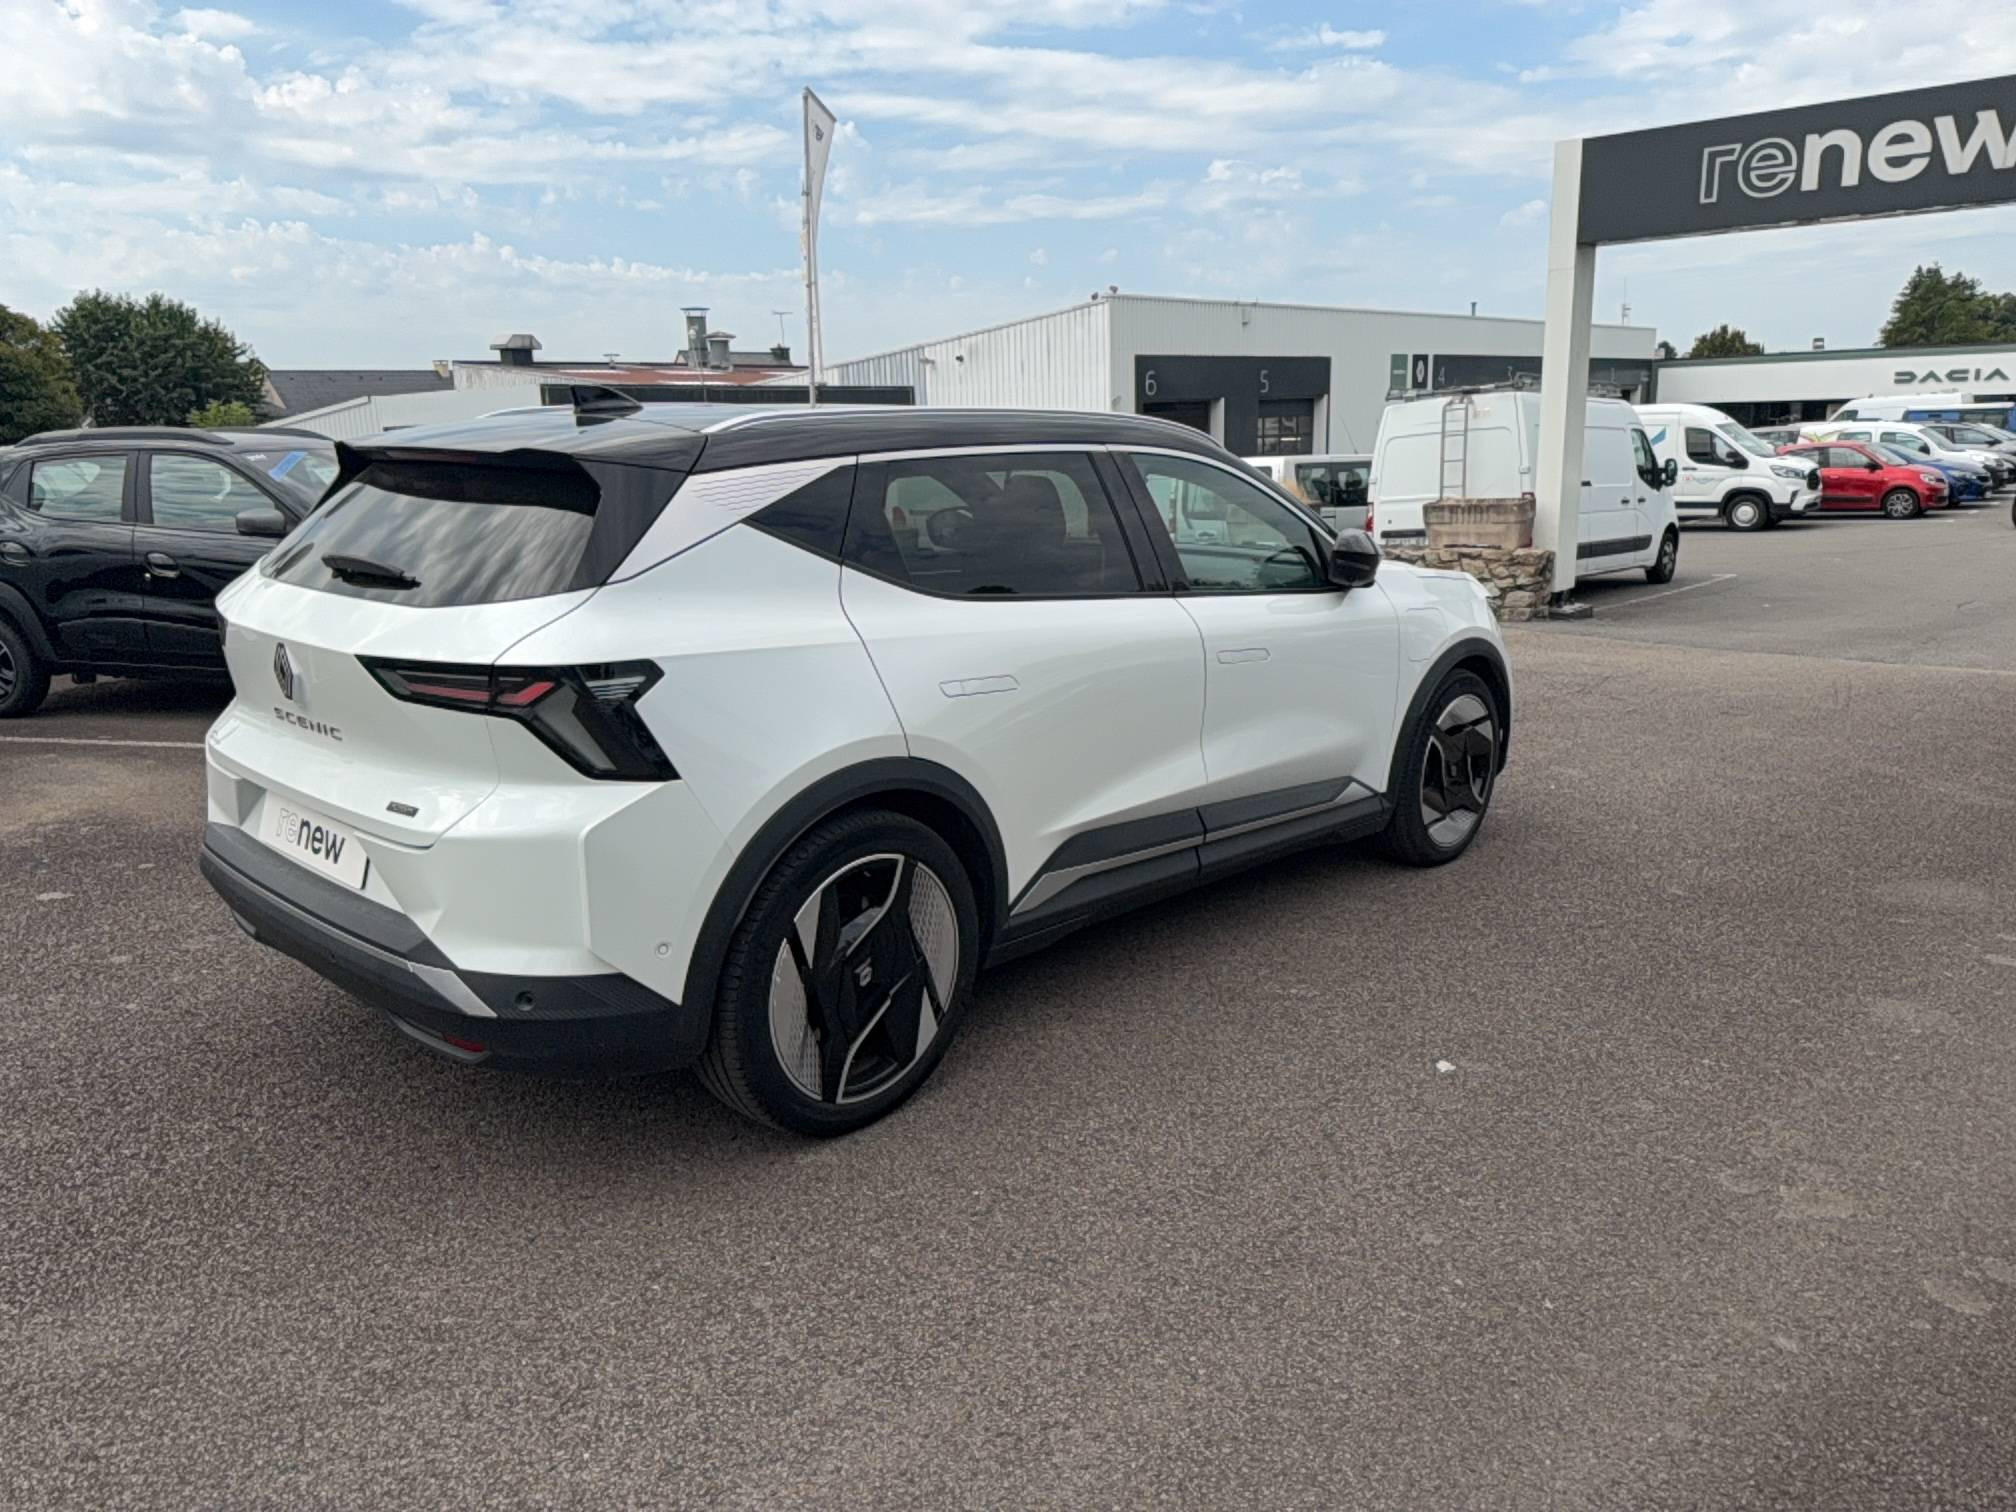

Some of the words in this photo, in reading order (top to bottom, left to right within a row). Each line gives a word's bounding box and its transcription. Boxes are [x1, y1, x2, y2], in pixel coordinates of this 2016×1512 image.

[1700, 109, 2016, 203] renew
[1145, 370, 1157, 396] 6
[1260, 370, 1269, 393] 5
[1894, 368, 2010, 384] DACIA
[273, 706, 343, 741] SCENIC
[276, 807, 346, 864] renew
